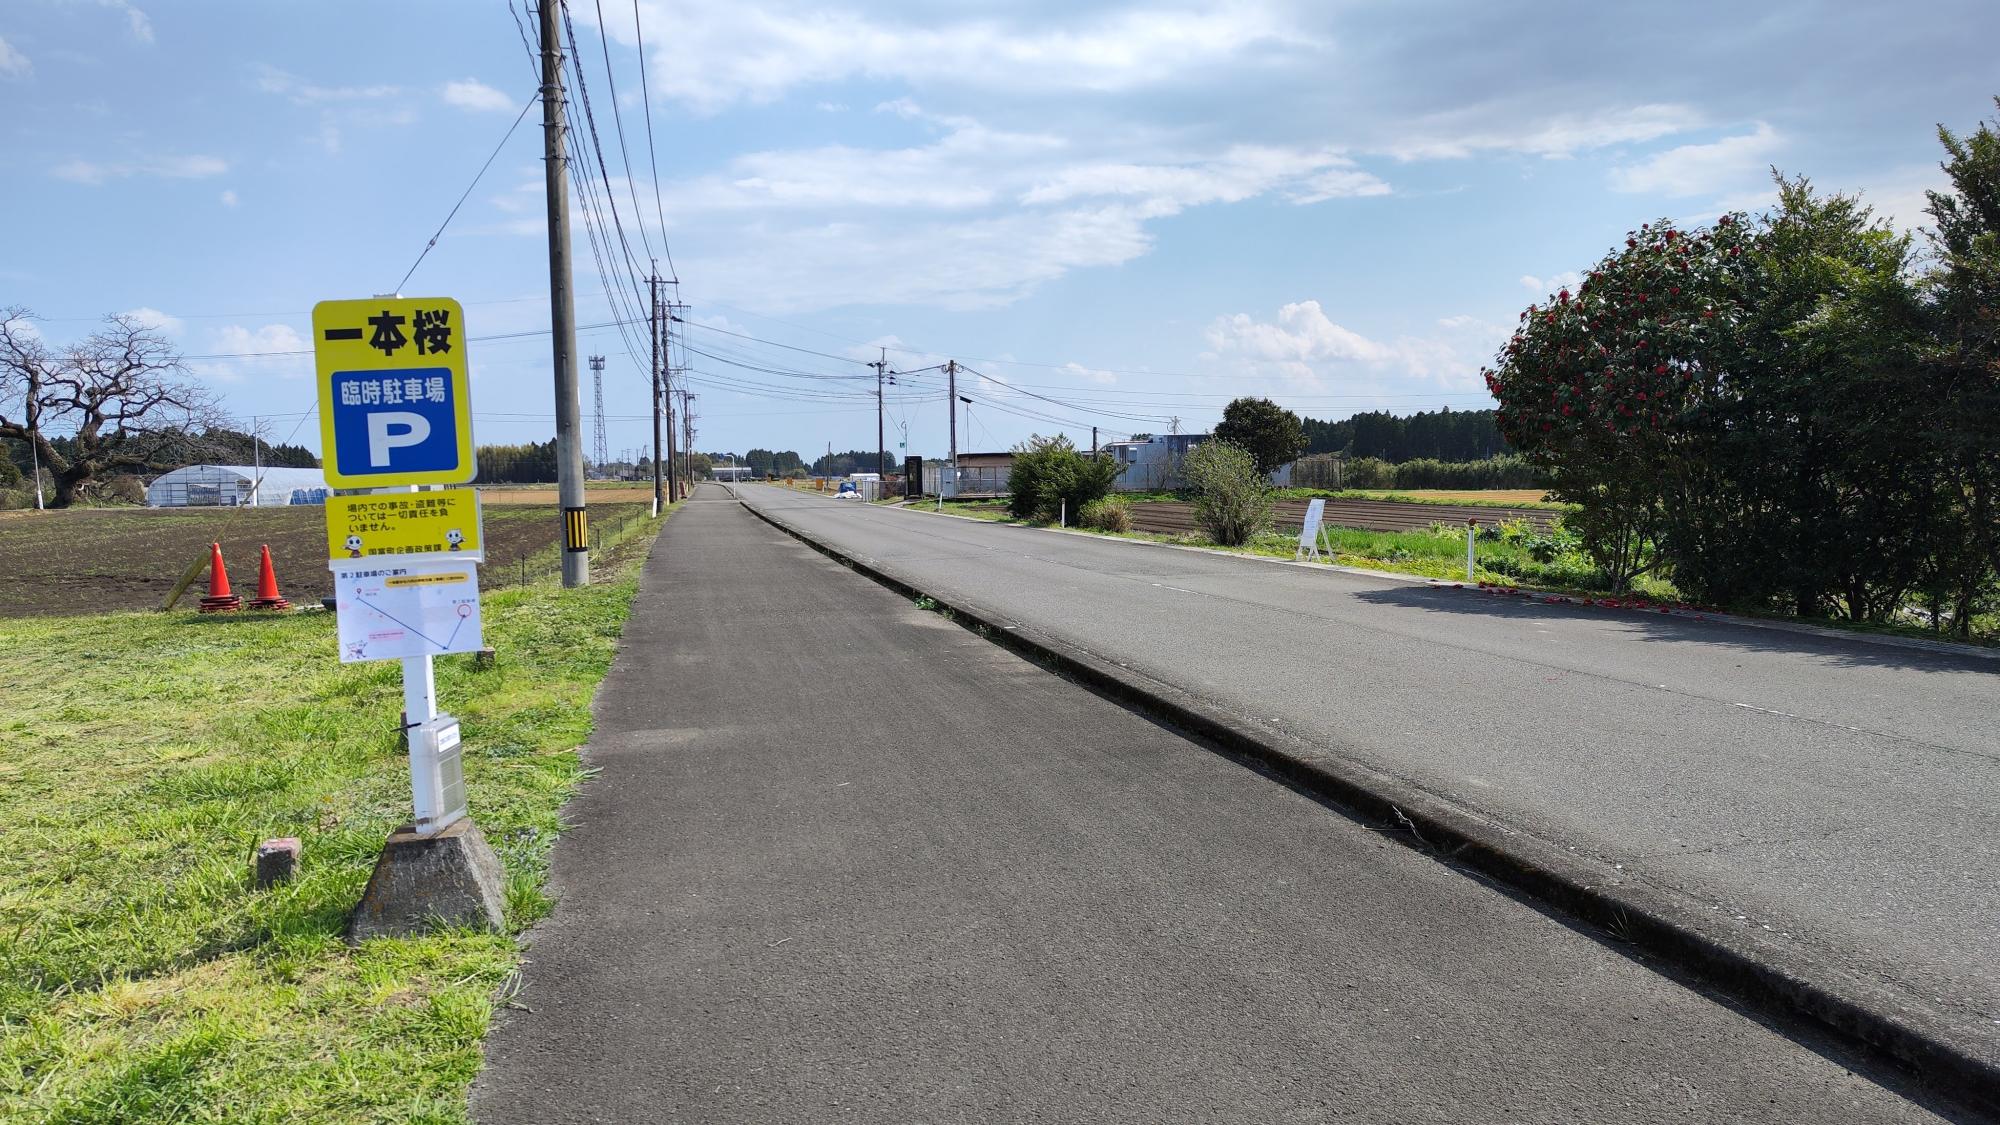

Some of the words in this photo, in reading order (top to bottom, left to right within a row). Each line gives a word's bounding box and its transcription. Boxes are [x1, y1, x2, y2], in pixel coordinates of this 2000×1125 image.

[325, 310, 452, 356] 一本桜
[341, 377, 445, 405] 臨時駐車場
[367, 411, 431, 467] P
[347, 508, 449, 521] ついては一切責任を負
[348, 522, 396, 532] いません。
